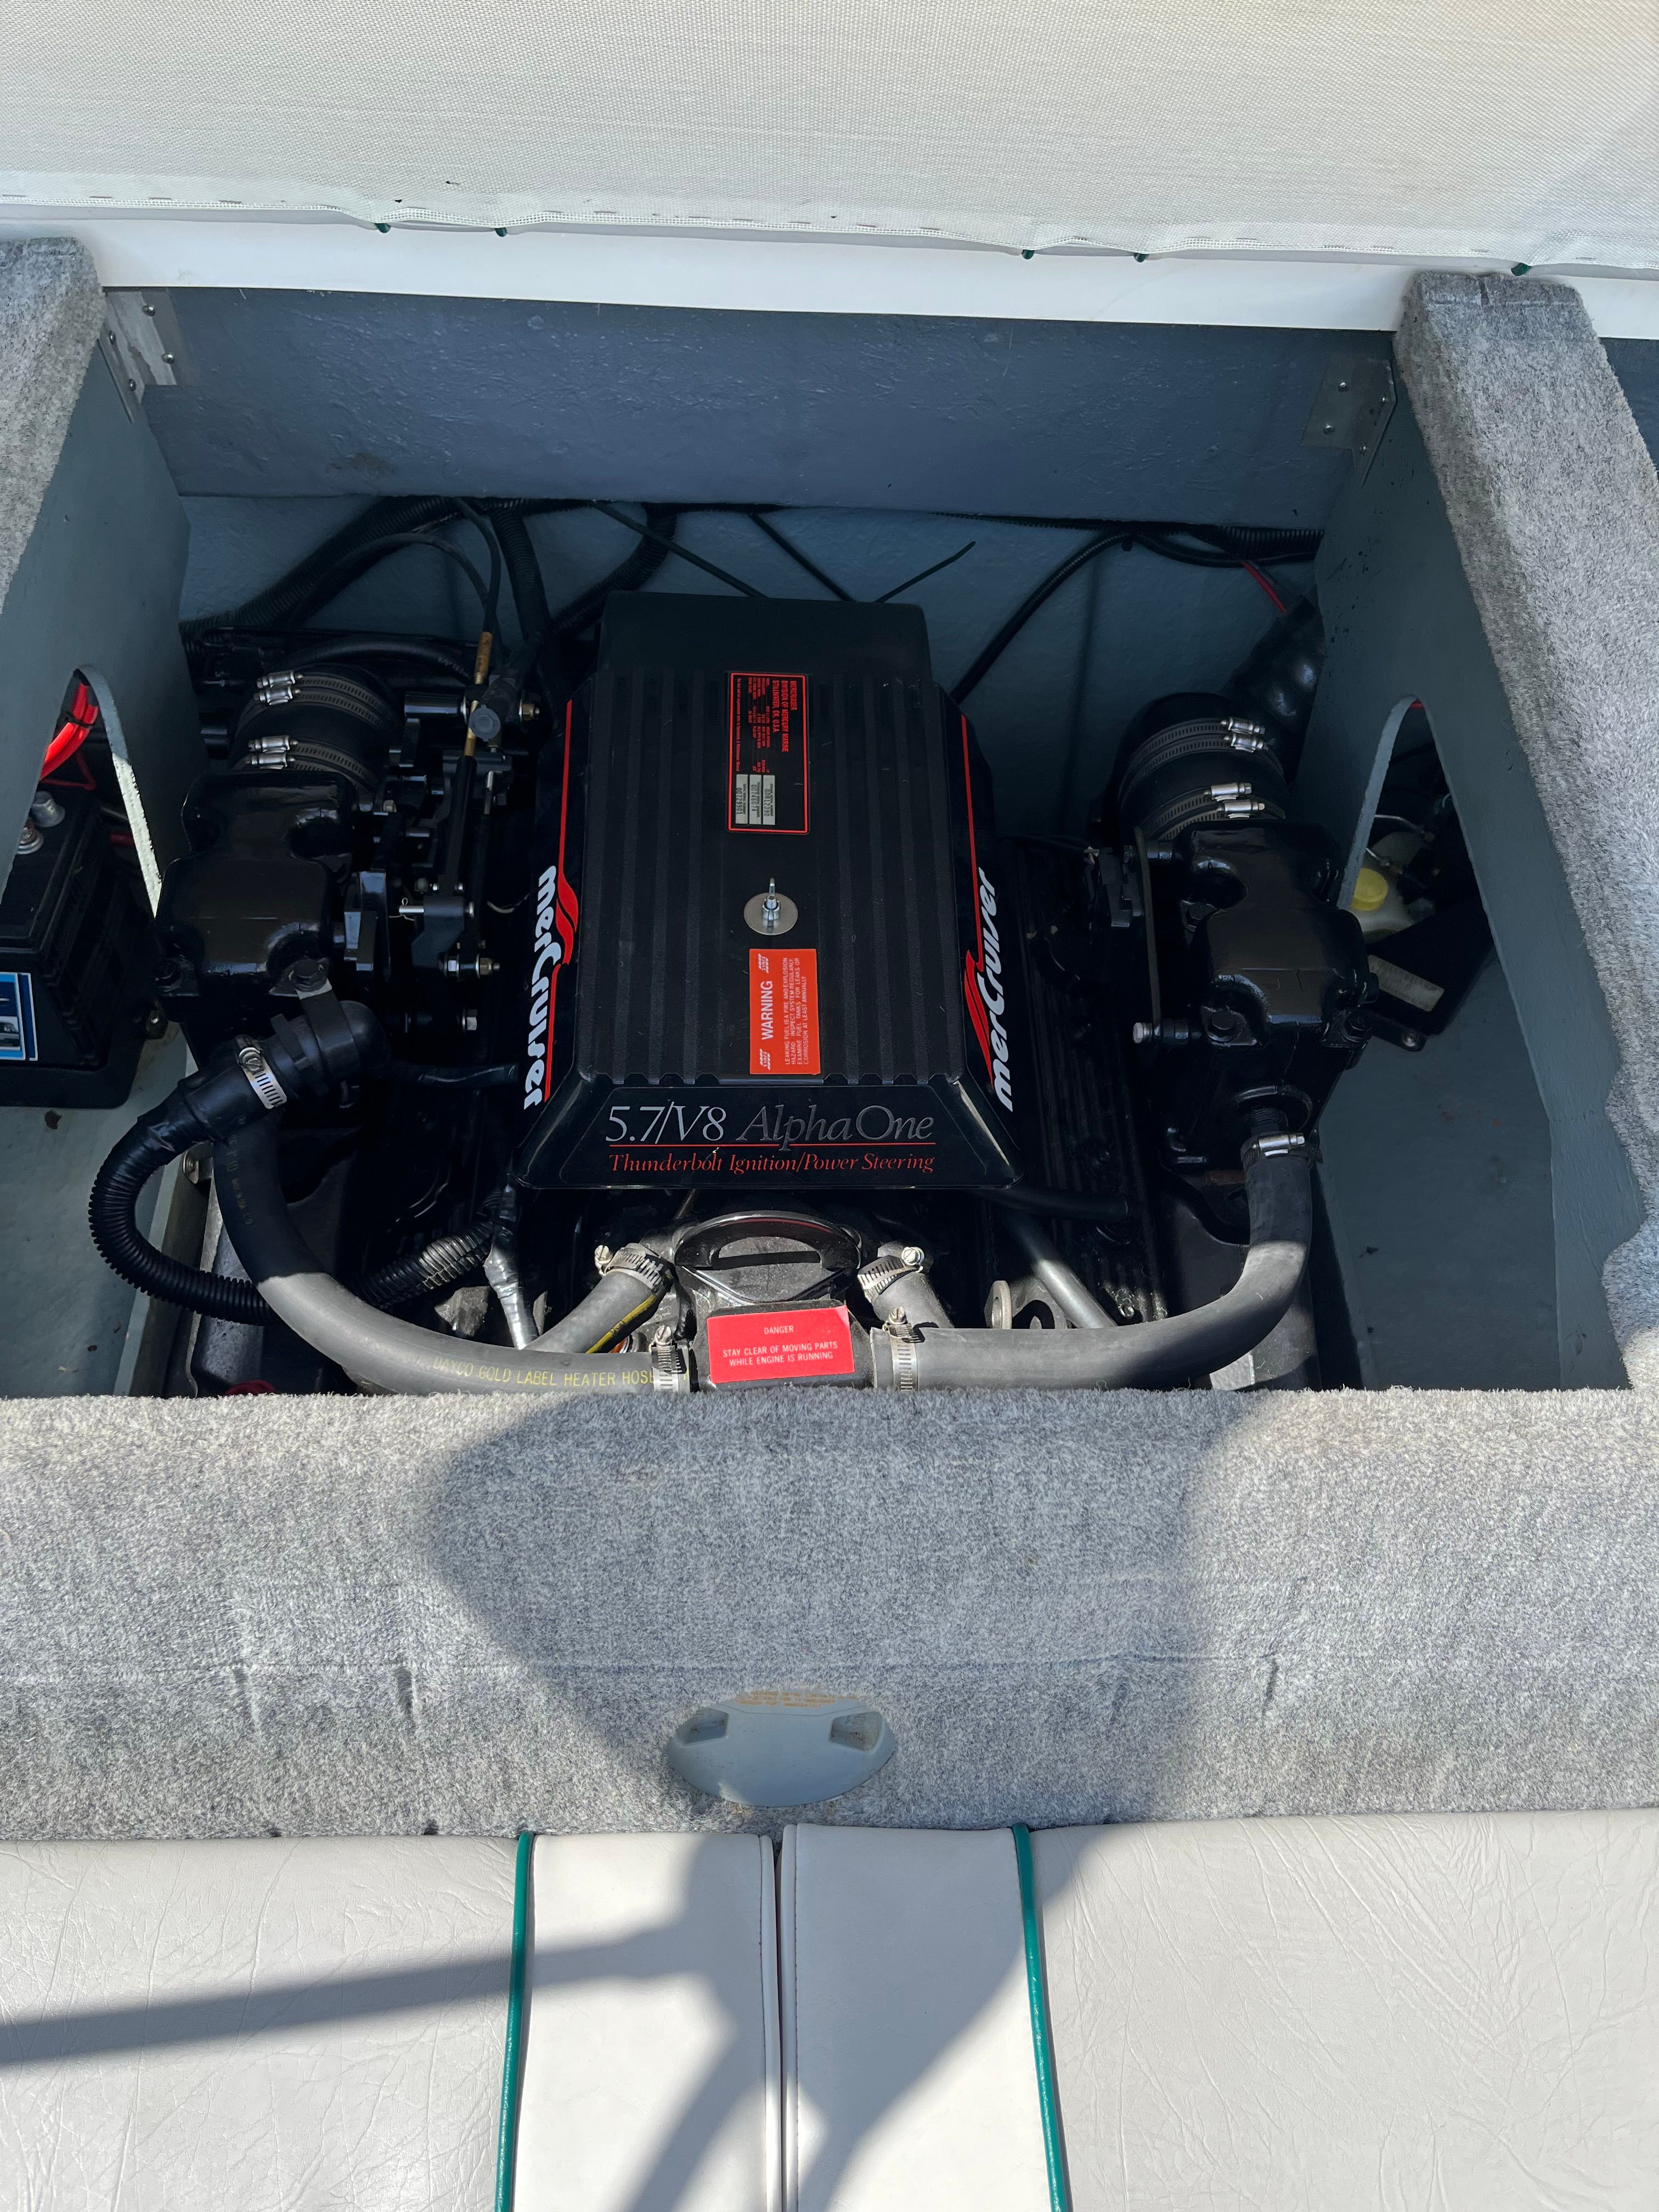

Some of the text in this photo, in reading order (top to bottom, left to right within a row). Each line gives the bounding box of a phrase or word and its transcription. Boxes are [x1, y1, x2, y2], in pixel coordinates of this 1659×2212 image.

[761, 981, 774, 1040] WARNING
[606, 1102, 934, 1151] 5.7/V8 Alpha One
[609, 1152, 935, 1175] Thunderbolt Ignition/Power Steering
[764, 1325, 794, 1334] DANGER
[723, 1348, 741, 1357] STAY
[744, 1346, 767, 1355] CLEAR
[782, 1343, 812, 1352] MOVING
[815, 1341, 838, 1350] PARTS
[729, 1357, 753, 1367] WHILE
[757, 1355, 785, 1364] ENGINE
[798, 1352, 833, 1361] RUNNING
[432, 1356, 473, 1376] DAYCO
[478, 1365, 511, 1382] GOLD
[517, 1370, 557, 1386] LABEL
[564, 1372, 616, 1386] HEATER
